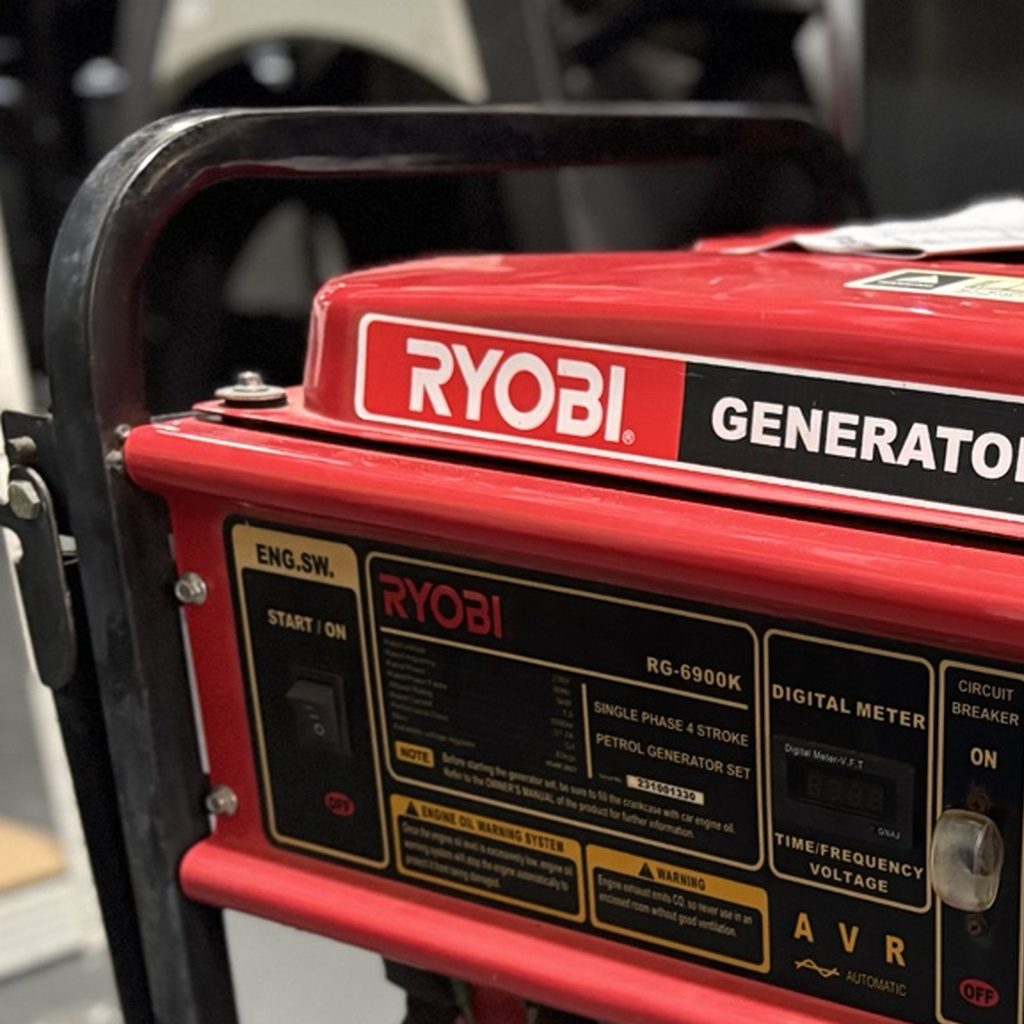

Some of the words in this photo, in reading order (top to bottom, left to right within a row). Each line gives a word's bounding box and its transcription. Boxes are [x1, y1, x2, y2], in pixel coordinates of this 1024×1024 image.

[405, 336, 626, 444] RYOBI
[255, 542, 336, 579] ENG.SW.
[378, 572, 503, 640] RYOBI
[267, 607, 313, 634] START
[323, 620, 348, 642] ON
[646, 655, 743, 692] RG-6900K
[957, 678, 1015, 702] CIRCUIT
[593, 700, 640, 723] SINGLE
[641, 711, 684, 732] PHASE
[685, 722, 694, 734] 4
[696, 724, 750, 748] STROKE
[771, 682, 852, 716] DIGITAL
[855, 699, 927, 732] METER
[951, 700, 1020, 727] BREAKER
[400, 747, 431, 765] NOTE
[595, 732, 645, 756] PETROL
[646, 744, 724, 774] GENERATOR
[726, 763, 751, 780] SET
[784, 742, 812, 758] Digital
[969, 745, 998, 771] ON
[421, 804, 457, 826] ENGINE
[477, 819, 523, 843] WARNING
[774, 831, 924, 881] TIME/FREQUENCY
[656, 867, 707, 892] WARNING
[808, 861, 889, 894] VOLTAGE
[846, 969, 908, 998] AUTOMATIC
[964, 984, 994, 1004] OFF
